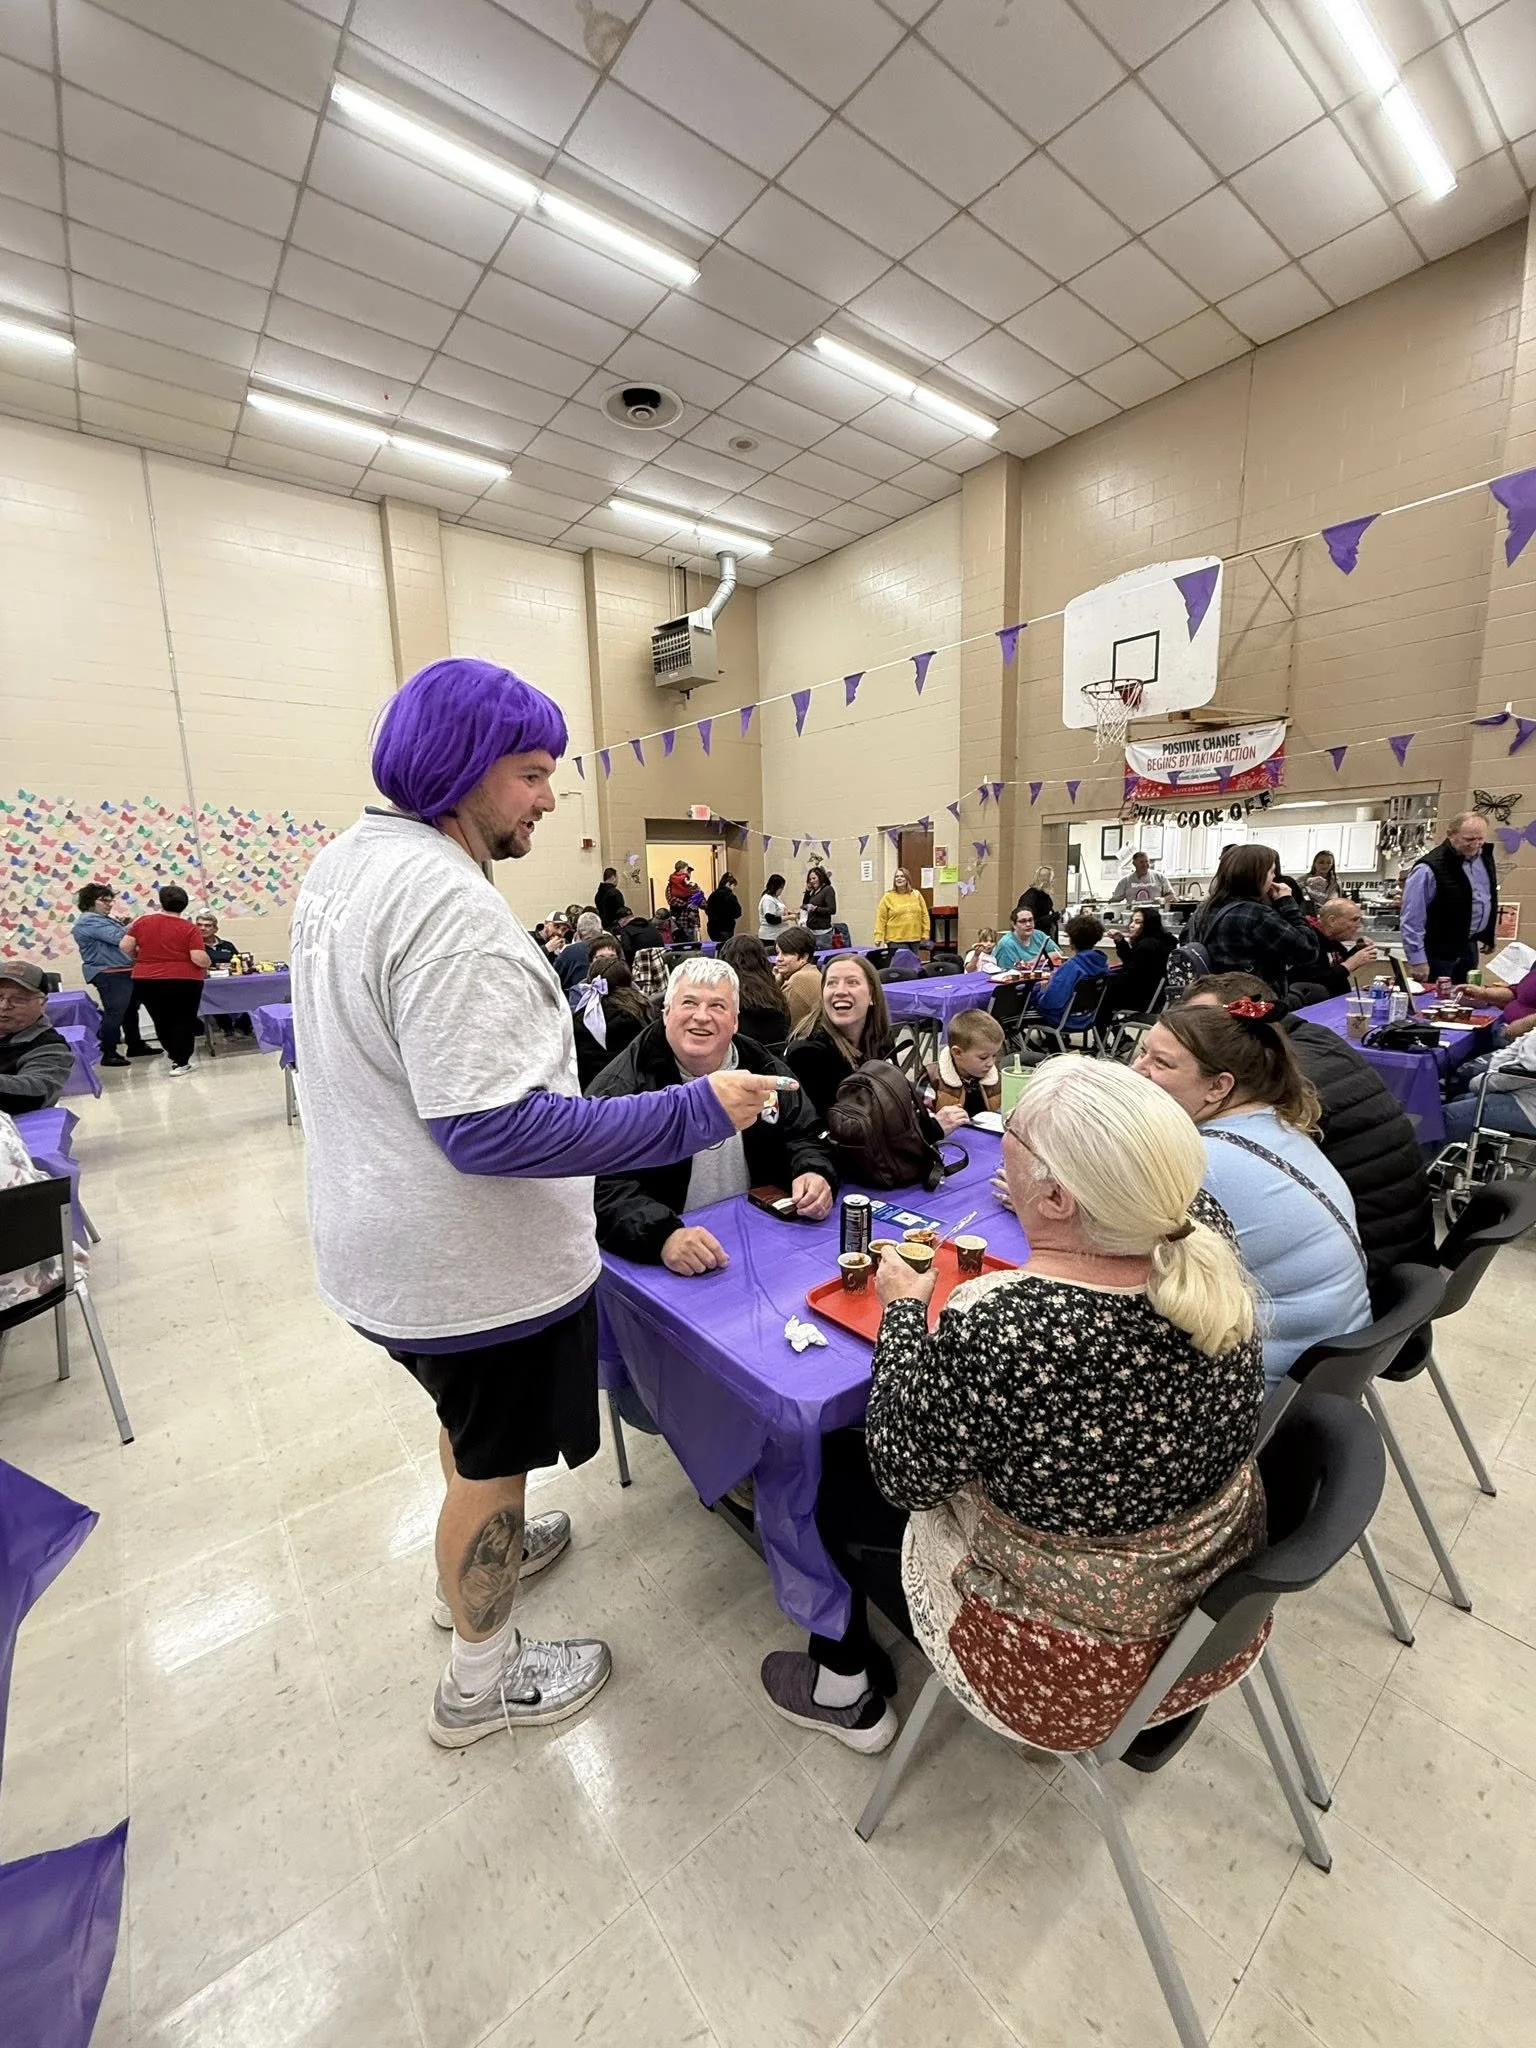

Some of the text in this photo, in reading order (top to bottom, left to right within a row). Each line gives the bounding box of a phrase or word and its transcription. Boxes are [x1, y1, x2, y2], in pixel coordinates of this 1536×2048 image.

[1162, 739, 1201, 756] POSITIVE
[1203, 733, 1241, 750] CHANGE
[1147, 746, 1256, 771] BEGINS BY TAKING ACTION
[1177, 807, 1223, 828] COOK
[1230, 790, 1270, 821] OFF
[1345, 881, 1364, 889] DEEP
[1365, 881, 1382, 889] FRE
